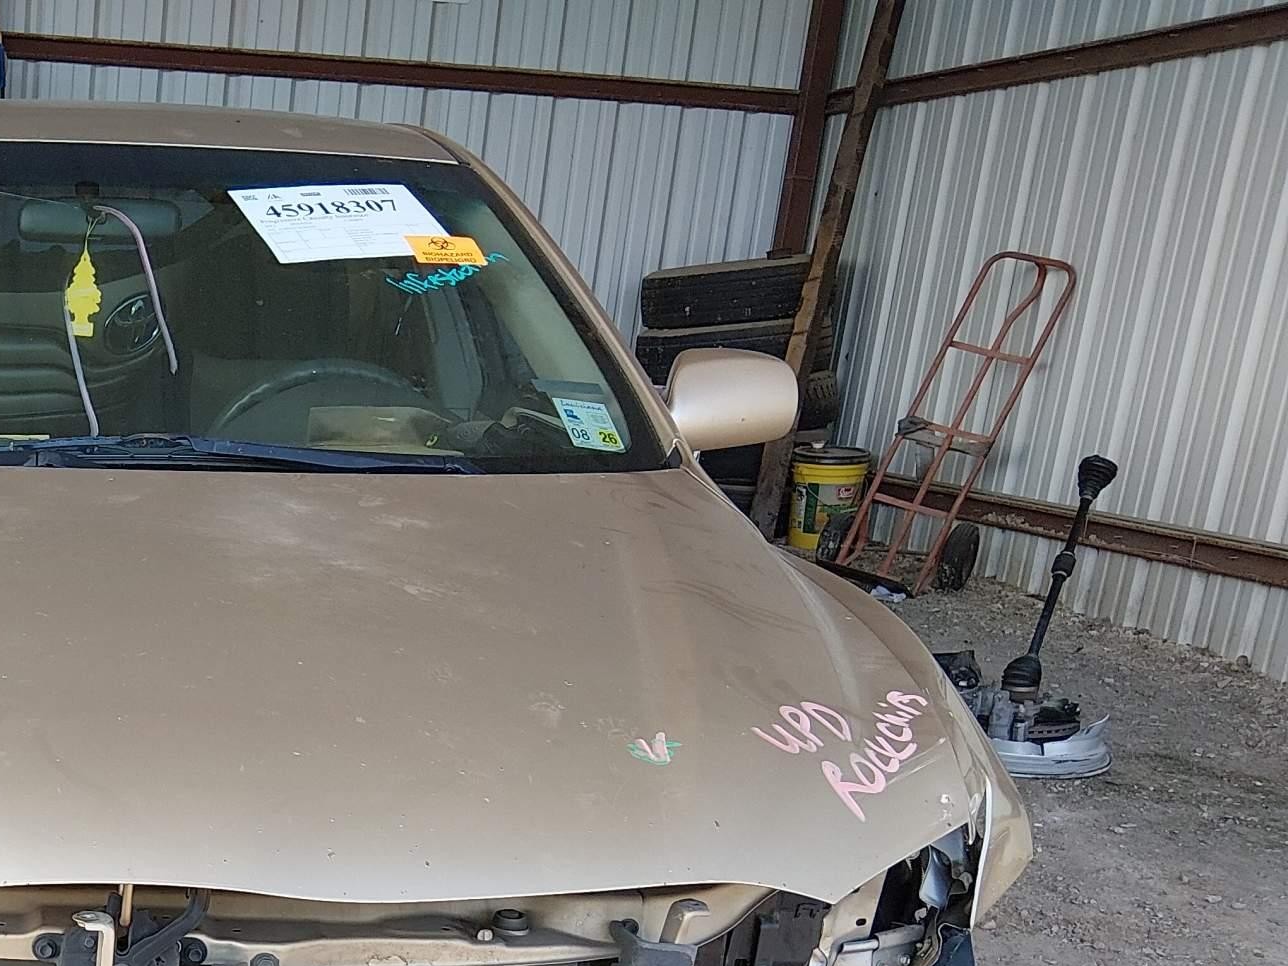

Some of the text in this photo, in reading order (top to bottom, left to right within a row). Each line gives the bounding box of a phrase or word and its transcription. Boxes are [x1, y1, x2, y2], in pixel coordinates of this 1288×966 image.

[265, 199, 399, 219] 45918307
[422, 251, 474, 259] BIOHAZARD
[571, 427, 590, 440] 08
[599, 431, 618, 445] 26
